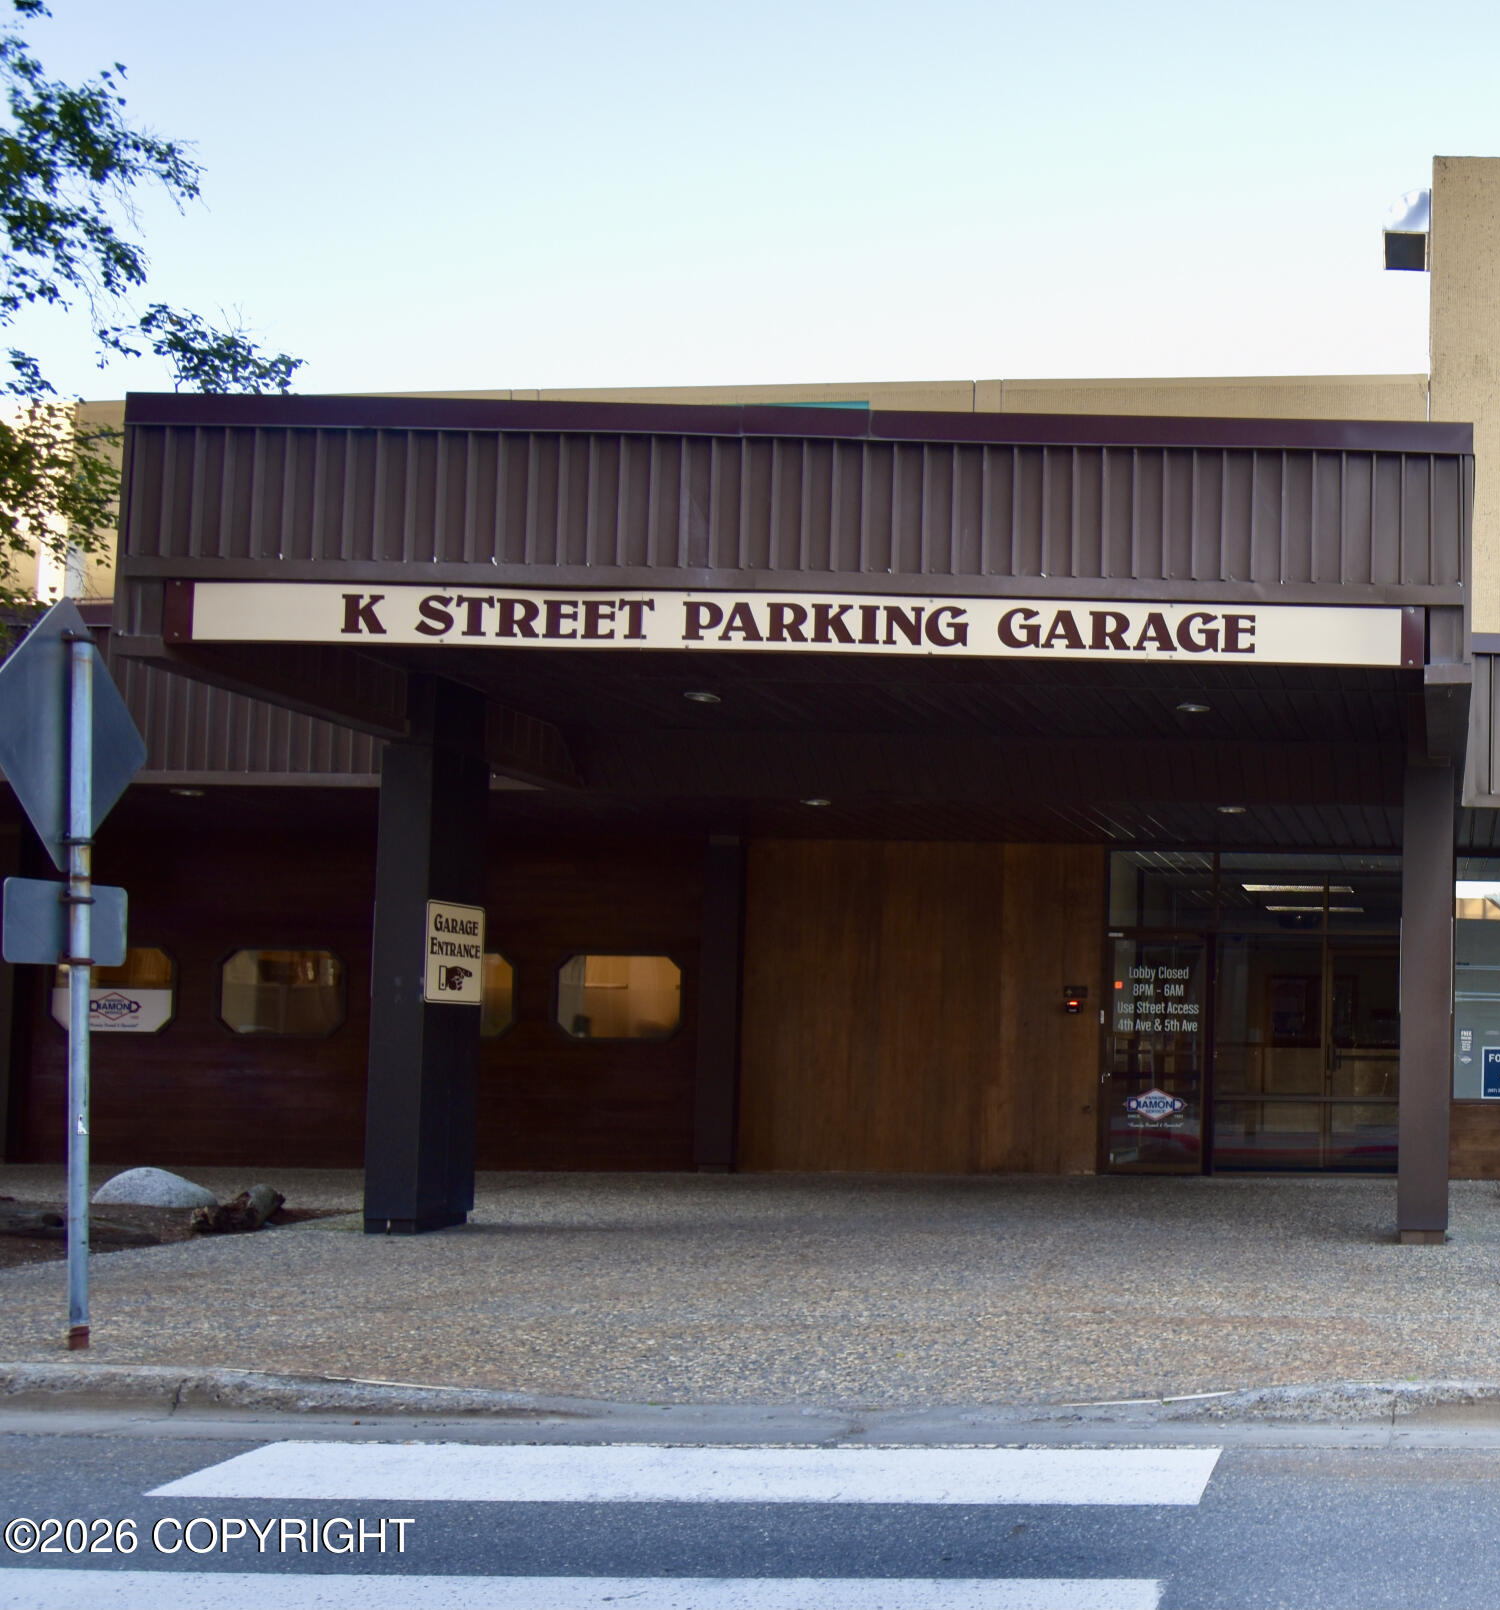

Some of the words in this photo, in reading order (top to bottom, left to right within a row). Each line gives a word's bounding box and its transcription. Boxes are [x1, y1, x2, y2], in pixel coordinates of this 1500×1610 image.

[341, 594, 387, 634] K
[414, 595, 655, 640] STREET
[682, 601, 969, 647] PARKING
[997, 607, 1256, 654] GARAGE
[434, 914, 479, 936] GARAGE
[430, 936, 481, 959] ENTRANCE
[1128, 966, 1156, 981] Lobby
[1158, 966, 1189, 979] Closed
[1132, 983, 1154, 996] 8PM
[1163, 984, 1184, 997] 6AM
[90, 1000, 140, 1013] DIAMOND
[1117, 1001, 1134, 1013] Use
[1136, 1001, 1165, 1014] Street
[1167, 1002, 1199, 1014] Access
[1118, 1018, 1133, 1031] 4th
[1135, 1019, 1152, 1031] Ave
[1153, 1018, 1162, 1031] &
[1164, 1019, 1180, 1031] 5th
[1182, 1019, 1198, 1032] Ave
[1127, 1097, 1185, 1112] DIAMOND
